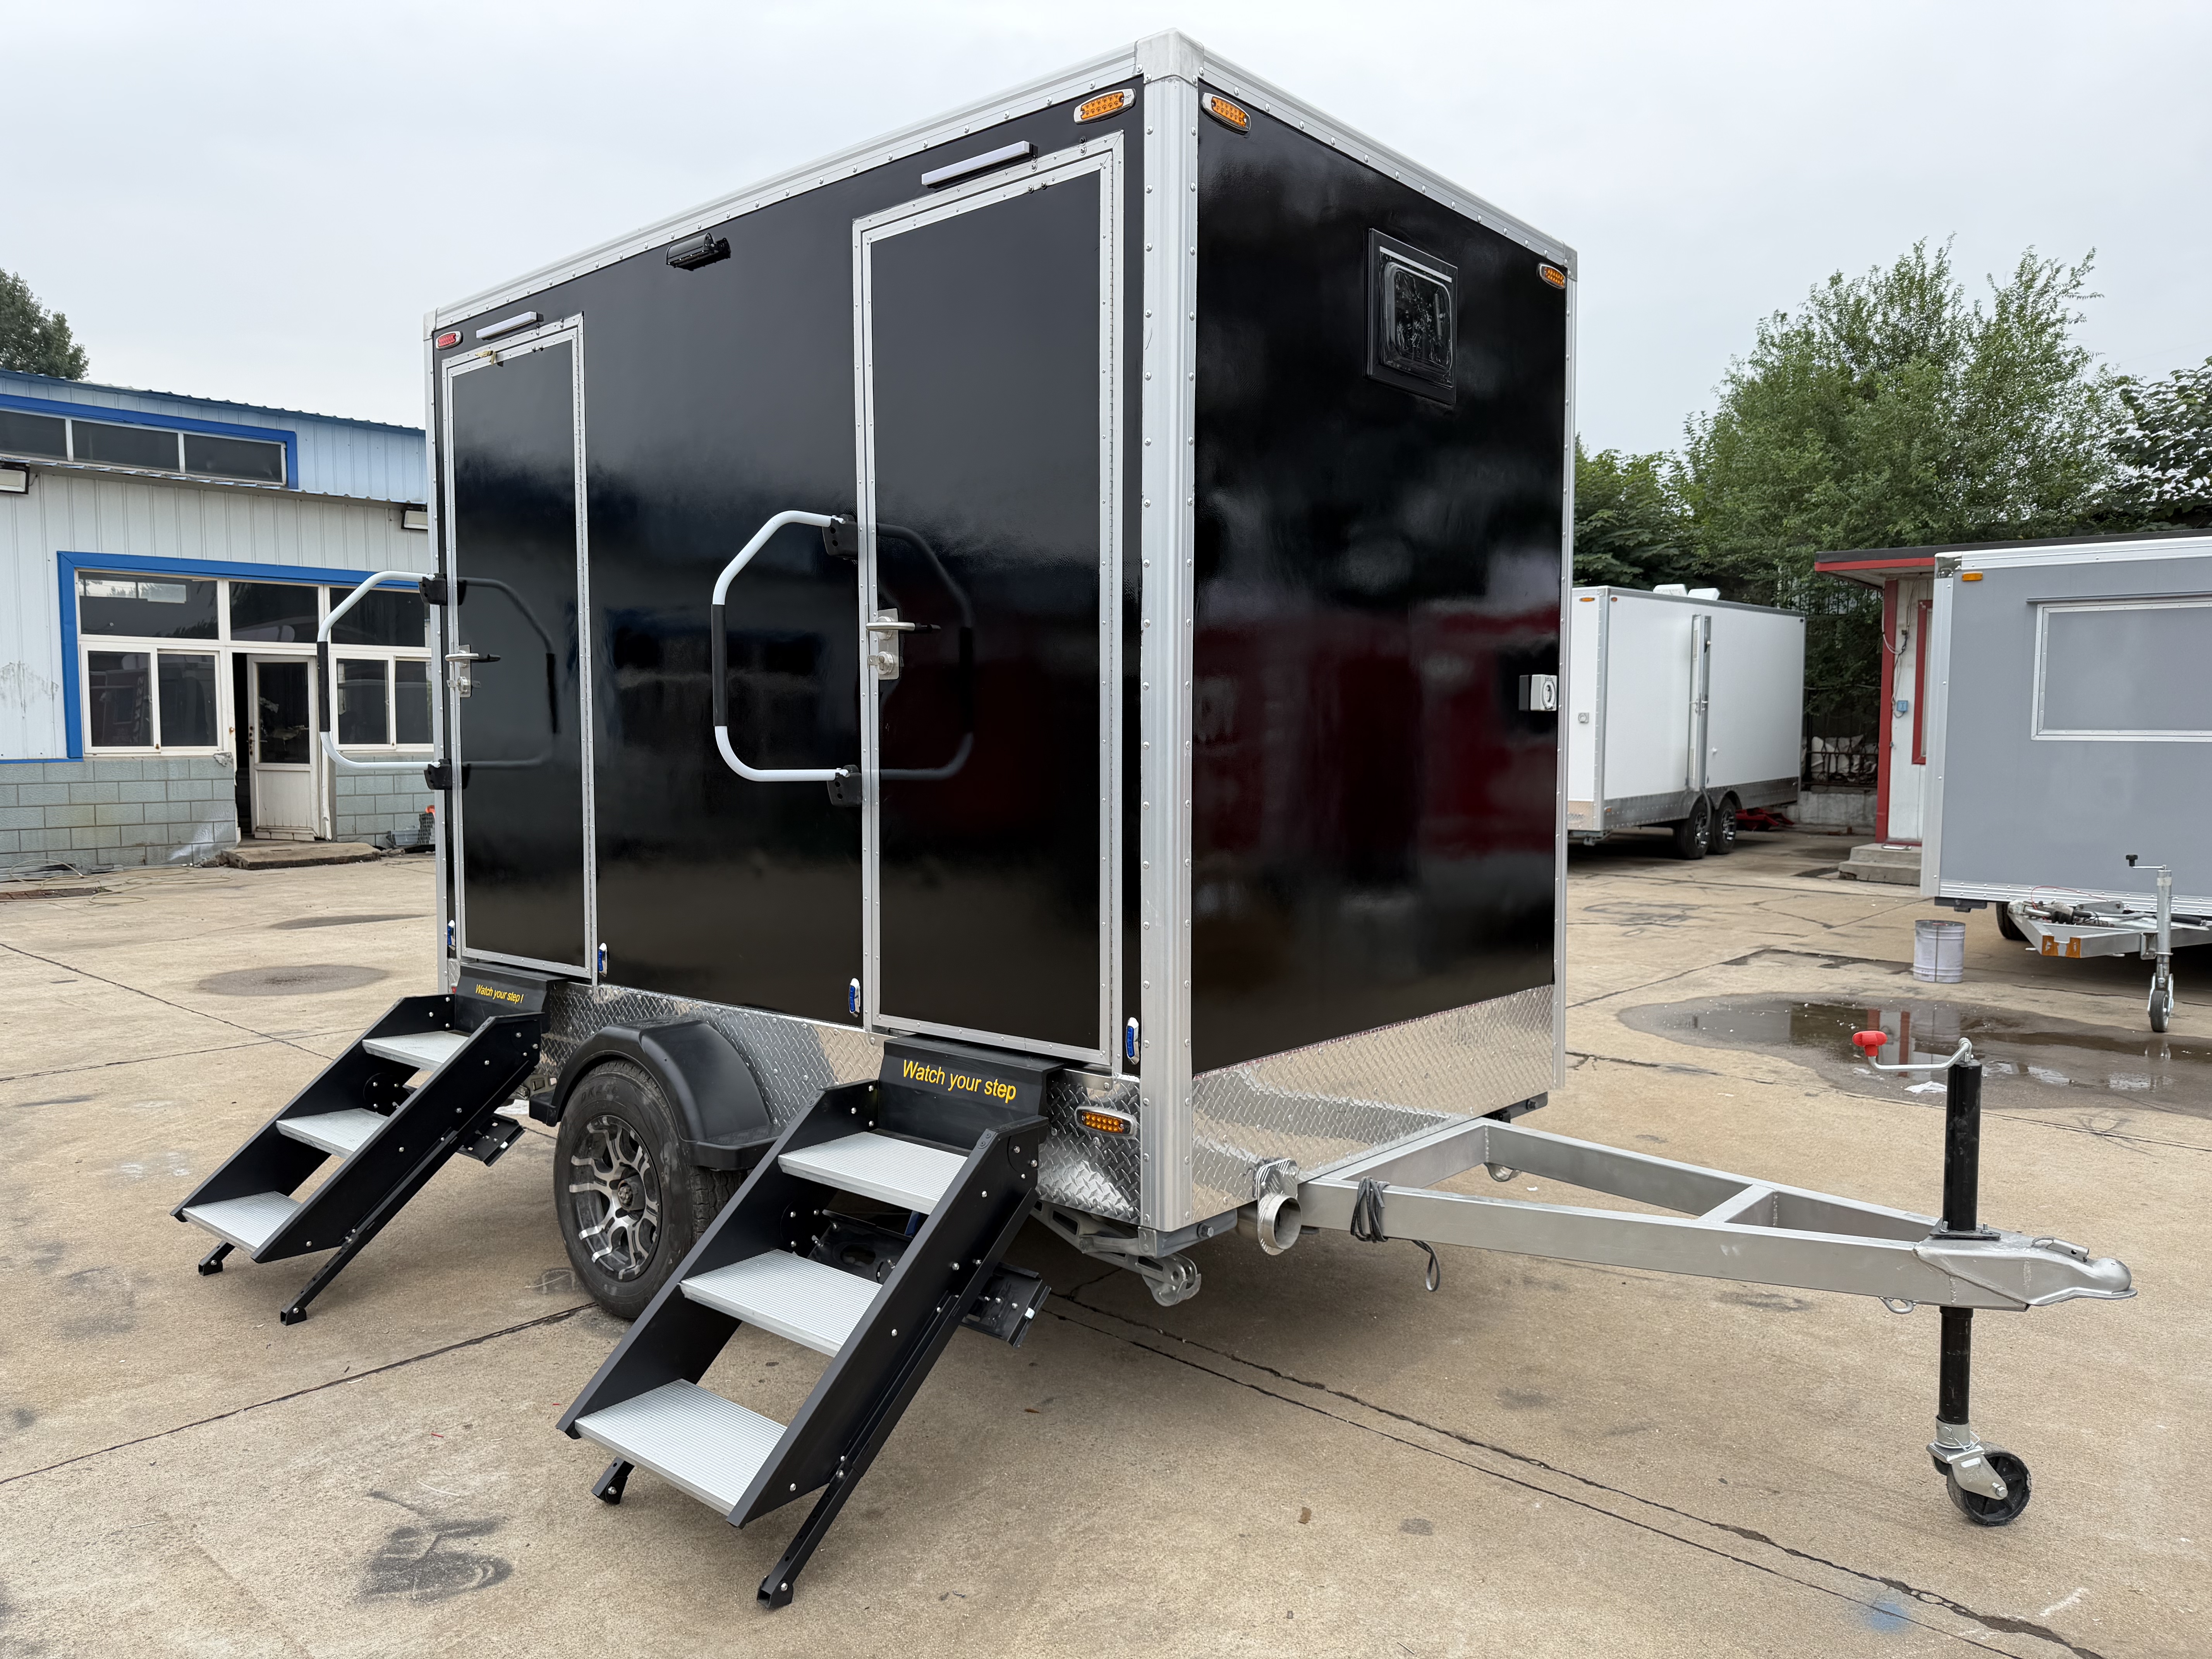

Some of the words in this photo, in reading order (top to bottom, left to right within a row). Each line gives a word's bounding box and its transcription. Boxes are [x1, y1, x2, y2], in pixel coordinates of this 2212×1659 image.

[476, 984, 493, 997] Watch
[493, 990, 508, 1000] your
[507, 992, 520, 1004] step
[903, 1060, 945, 1085] Watch
[948, 1073, 981, 1091] your
[984, 1079, 1017, 1103] step
